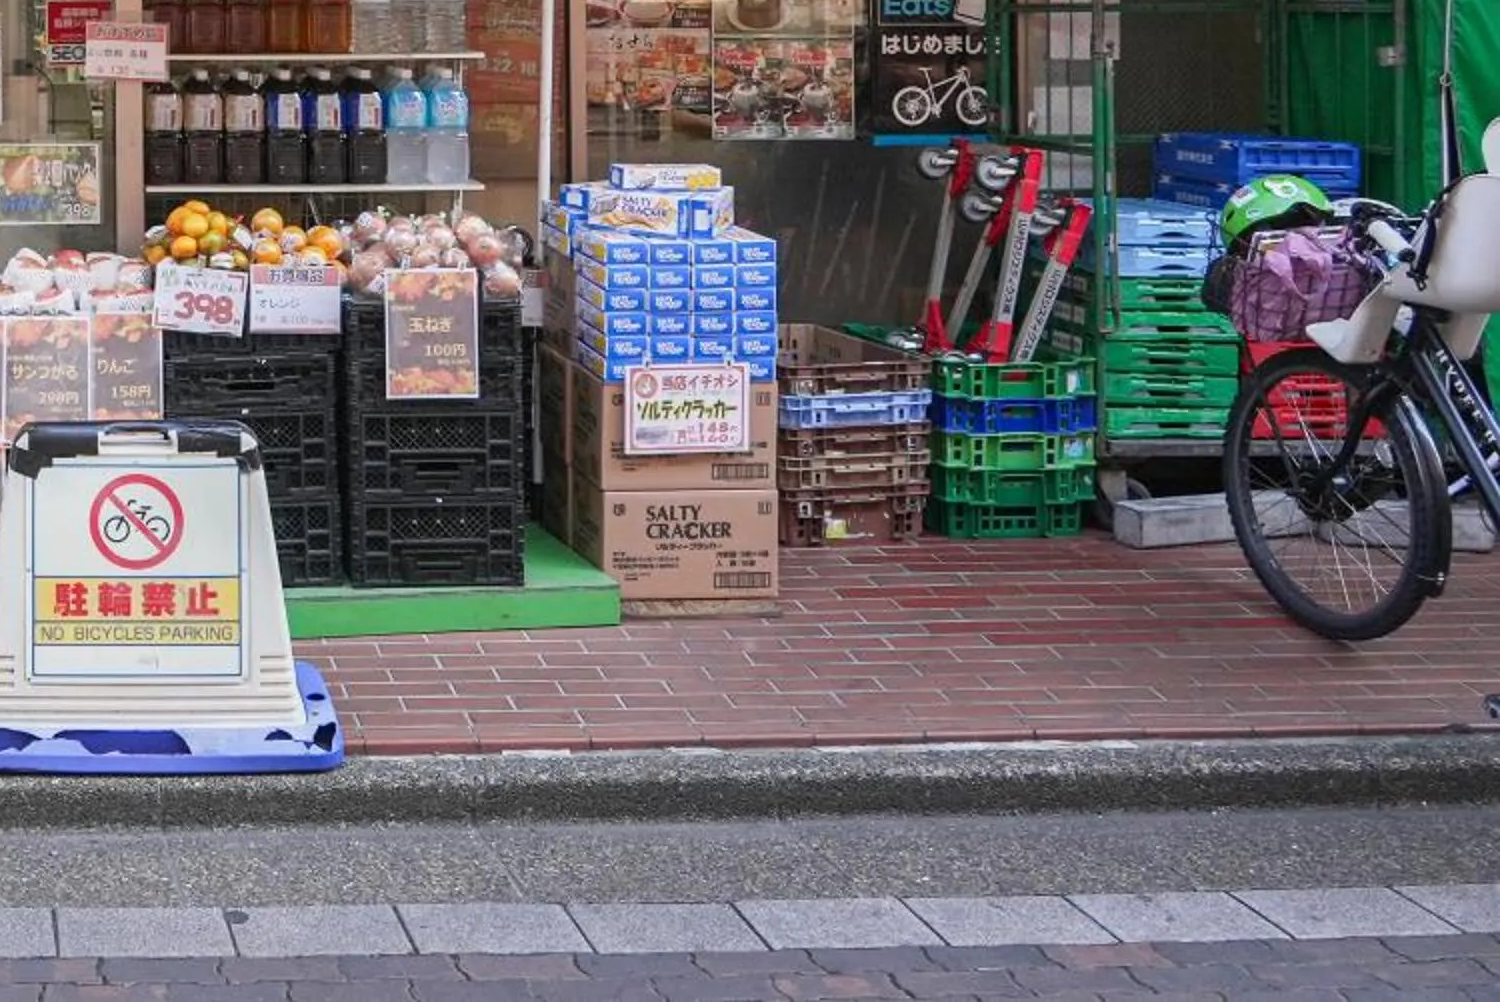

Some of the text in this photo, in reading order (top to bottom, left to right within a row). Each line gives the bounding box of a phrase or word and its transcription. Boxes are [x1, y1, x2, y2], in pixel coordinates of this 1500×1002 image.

[52, 46, 85, 60] SEC
[174, 291, 234, 324] 398
[258, 297, 301, 309] オレンジ
[409, 317, 453, 333] 玉ねぎ
[425, 343, 467, 356] 100円
[11, 363, 80, 380] サンつがる
[646, 504, 702, 522] SALTY
[646, 521, 732, 539] CRACKER
[54, 582, 219, 617] 駐輪禁止
[40, 625, 234, 641] NO BICYCLES PARKING
